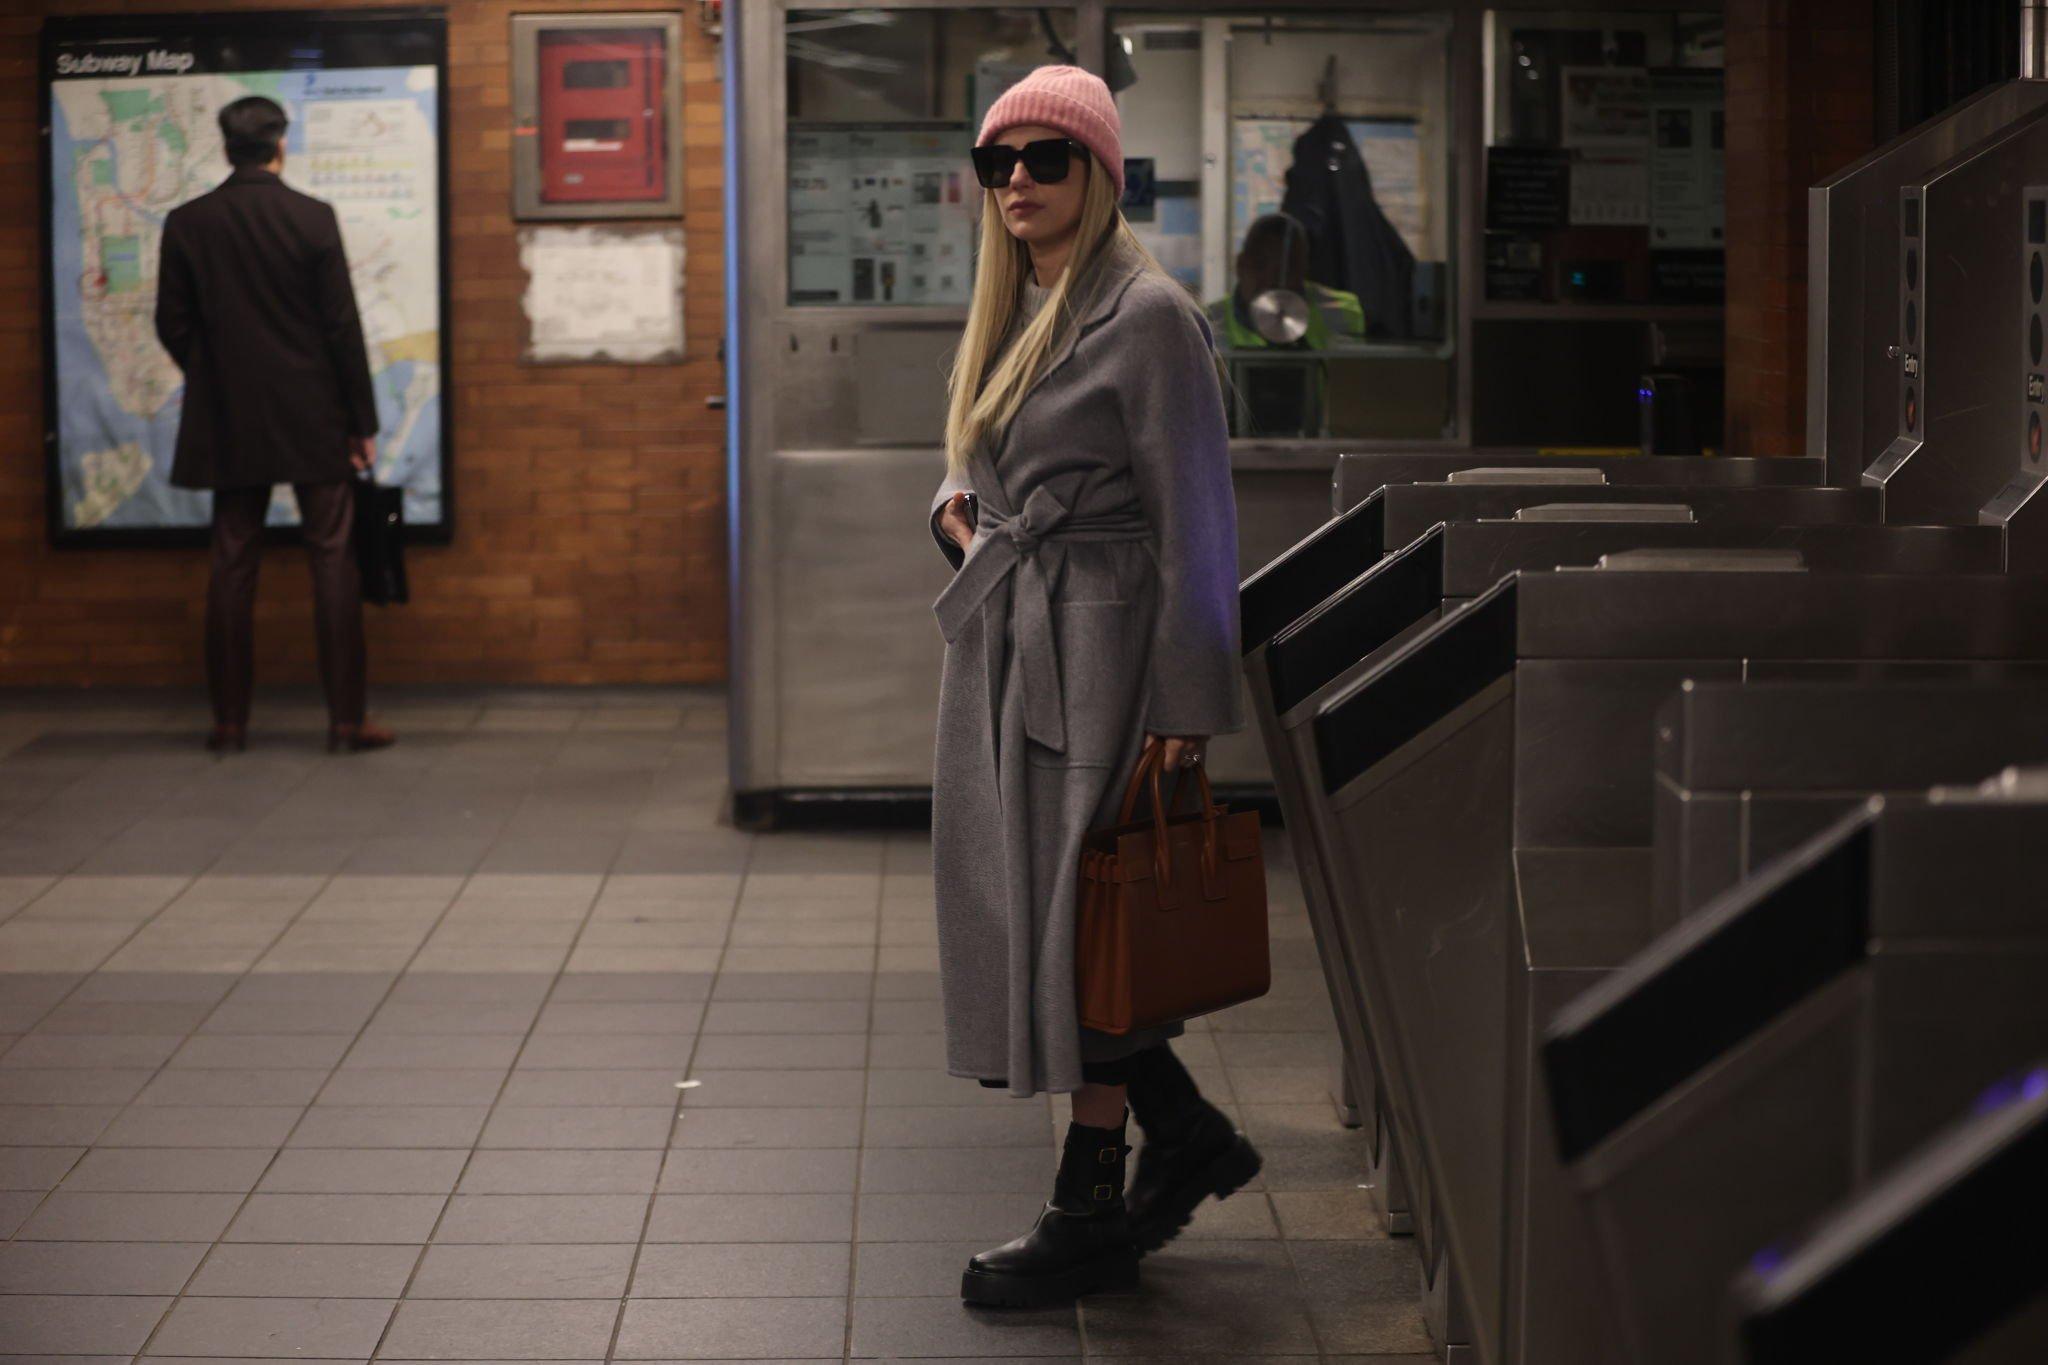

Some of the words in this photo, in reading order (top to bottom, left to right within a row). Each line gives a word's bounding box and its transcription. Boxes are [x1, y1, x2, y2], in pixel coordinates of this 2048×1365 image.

[56, 53, 143, 77] Subway
[147, 50, 195, 74] Map
[1904, 353, 1918, 378] Entry
